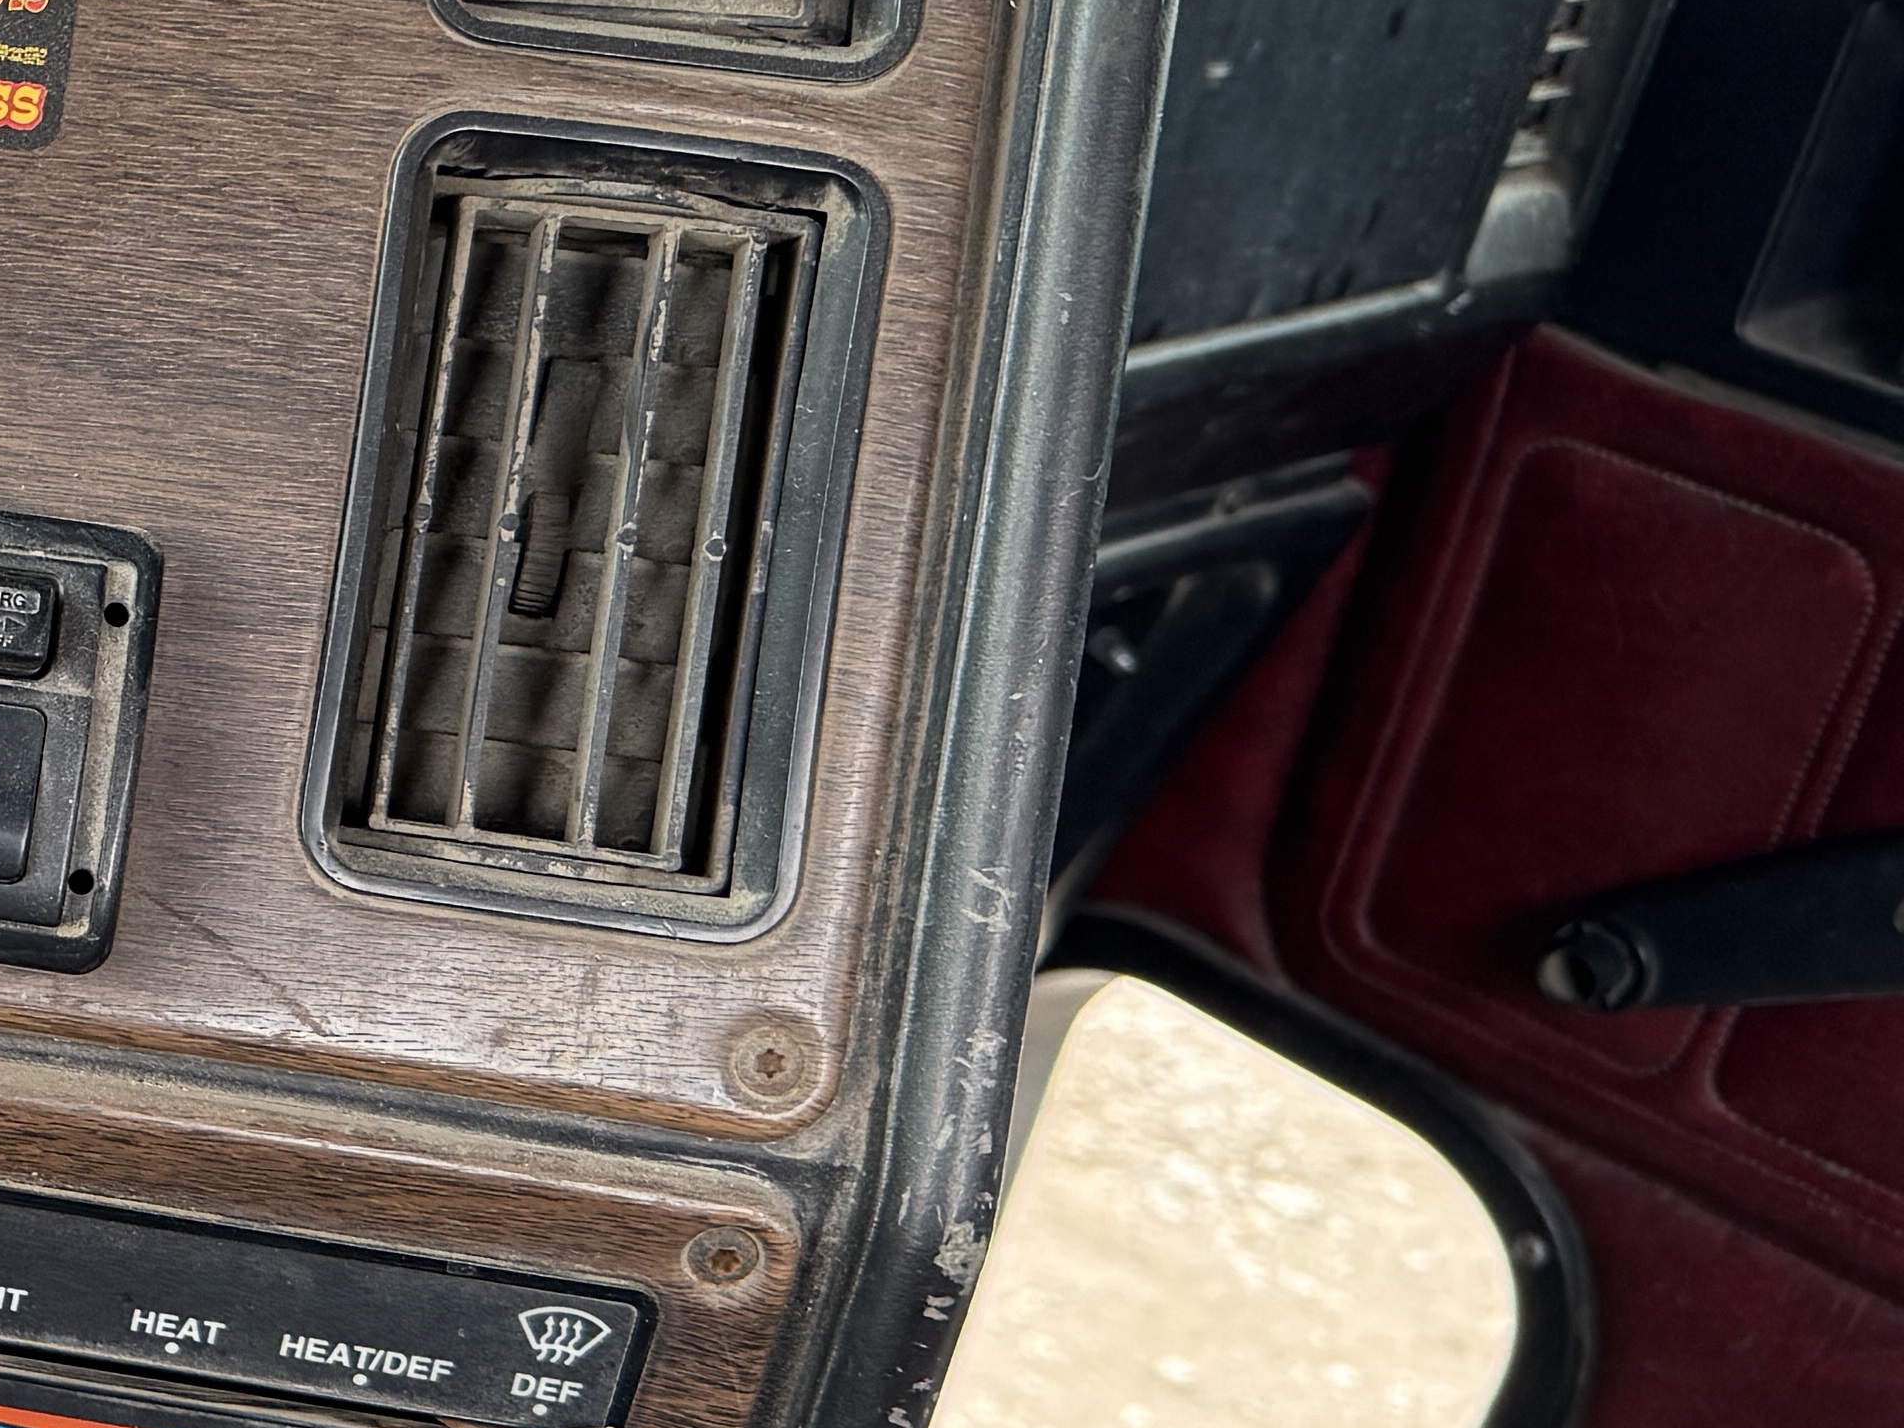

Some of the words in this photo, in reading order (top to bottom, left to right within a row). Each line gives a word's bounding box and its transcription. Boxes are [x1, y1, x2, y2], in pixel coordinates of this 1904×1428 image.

[129, 1307, 227, 1346] HEAT
[277, 1333, 455, 1384] HEAT/DEF
[509, 1371, 585, 1406] DEF
